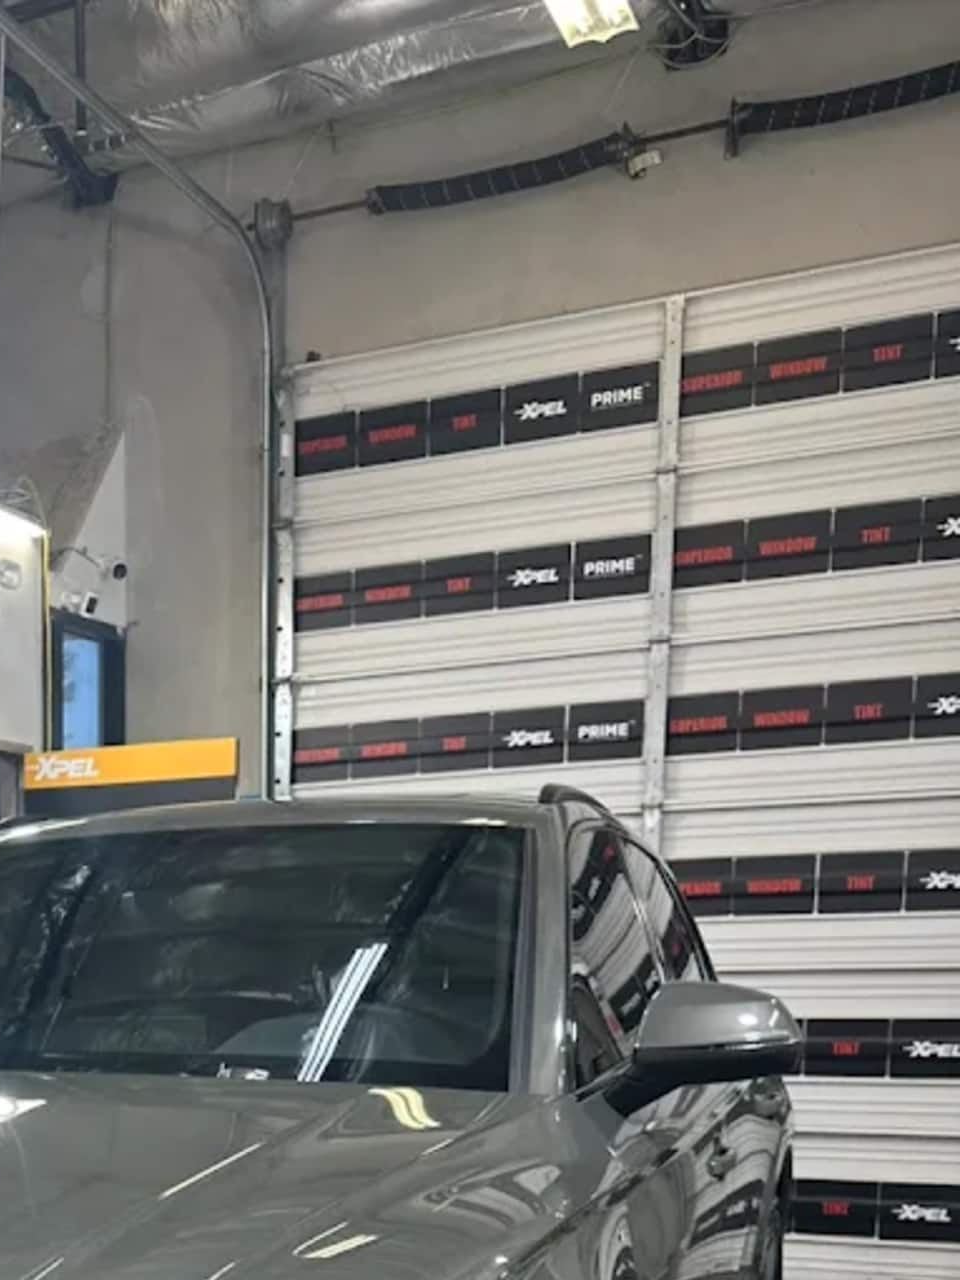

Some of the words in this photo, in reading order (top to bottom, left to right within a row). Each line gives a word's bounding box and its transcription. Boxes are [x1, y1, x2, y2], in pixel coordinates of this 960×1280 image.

[769, 356, 827, 380] WINDOW
[872, 344, 903, 362] TINT
[519, 399, 567, 422] XPEL
[590, 387, 644, 408] PRIME
[758, 535, 817, 556] WINDOW
[861, 526, 892, 544] TINT
[511, 567, 559, 588] XPEL
[583, 560, 636, 577] PRIME
[753, 708, 810, 727] WINDOW
[853, 703, 883, 720] TINT
[577, 720, 630, 740] PRIME
[34, 756, 100, 781] XPEL
[898, 1203, 951, 1223] XPEL
